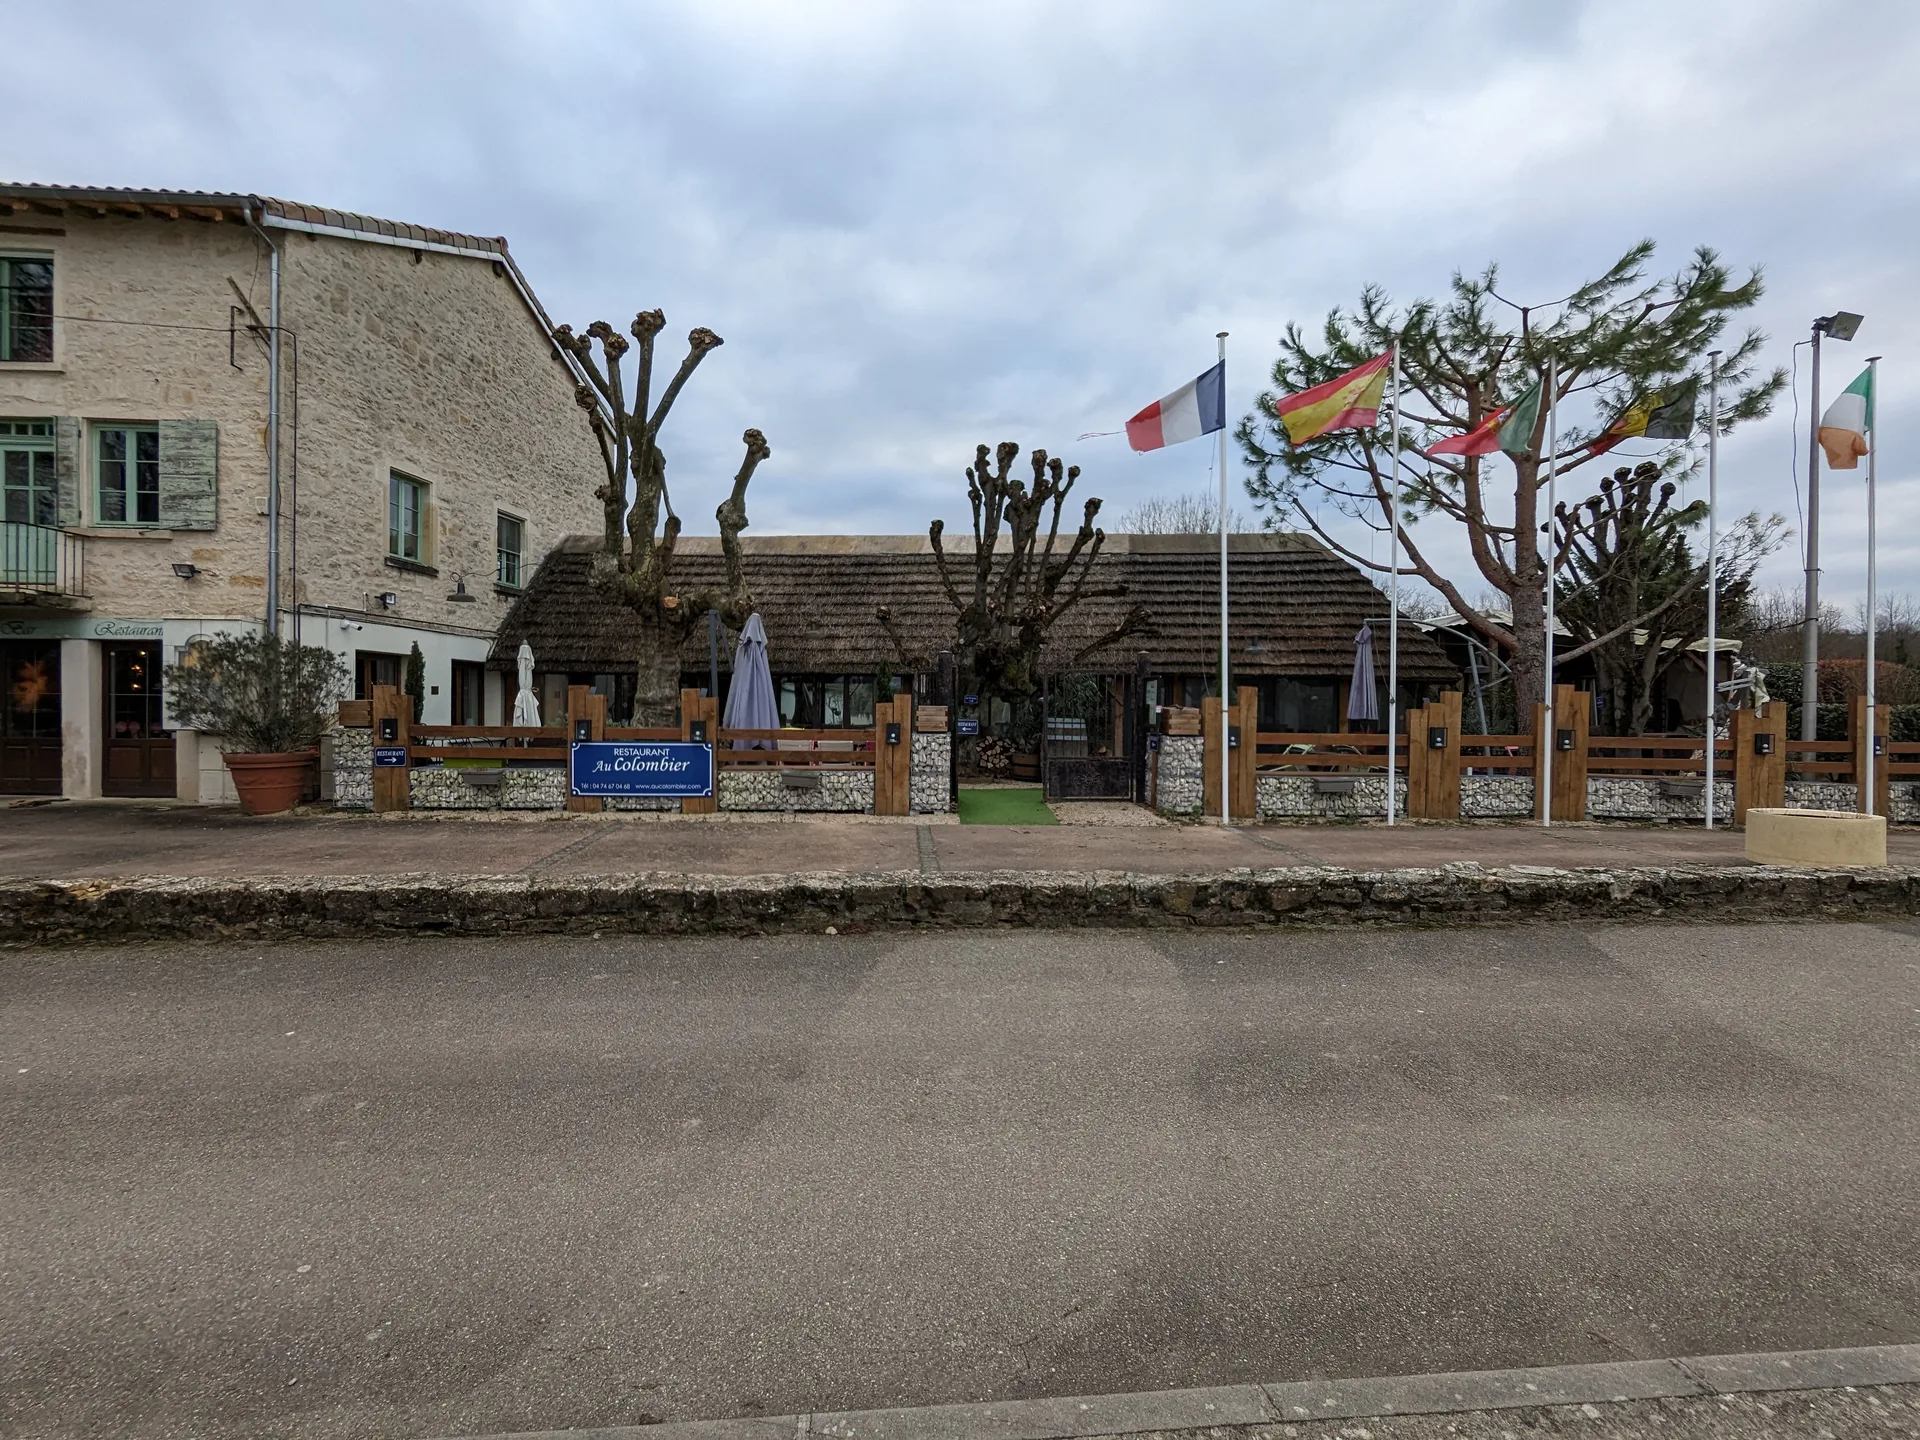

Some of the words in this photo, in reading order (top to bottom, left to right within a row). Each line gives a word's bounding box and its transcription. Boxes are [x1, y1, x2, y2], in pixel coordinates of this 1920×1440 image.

[2, 621, 37, 635] Bar
[94, 621, 163, 636] Restauran
[614, 748, 670, 756] RESTAURANT
[592, 760, 612, 773] Au
[614, 756, 690, 772] Colombier
